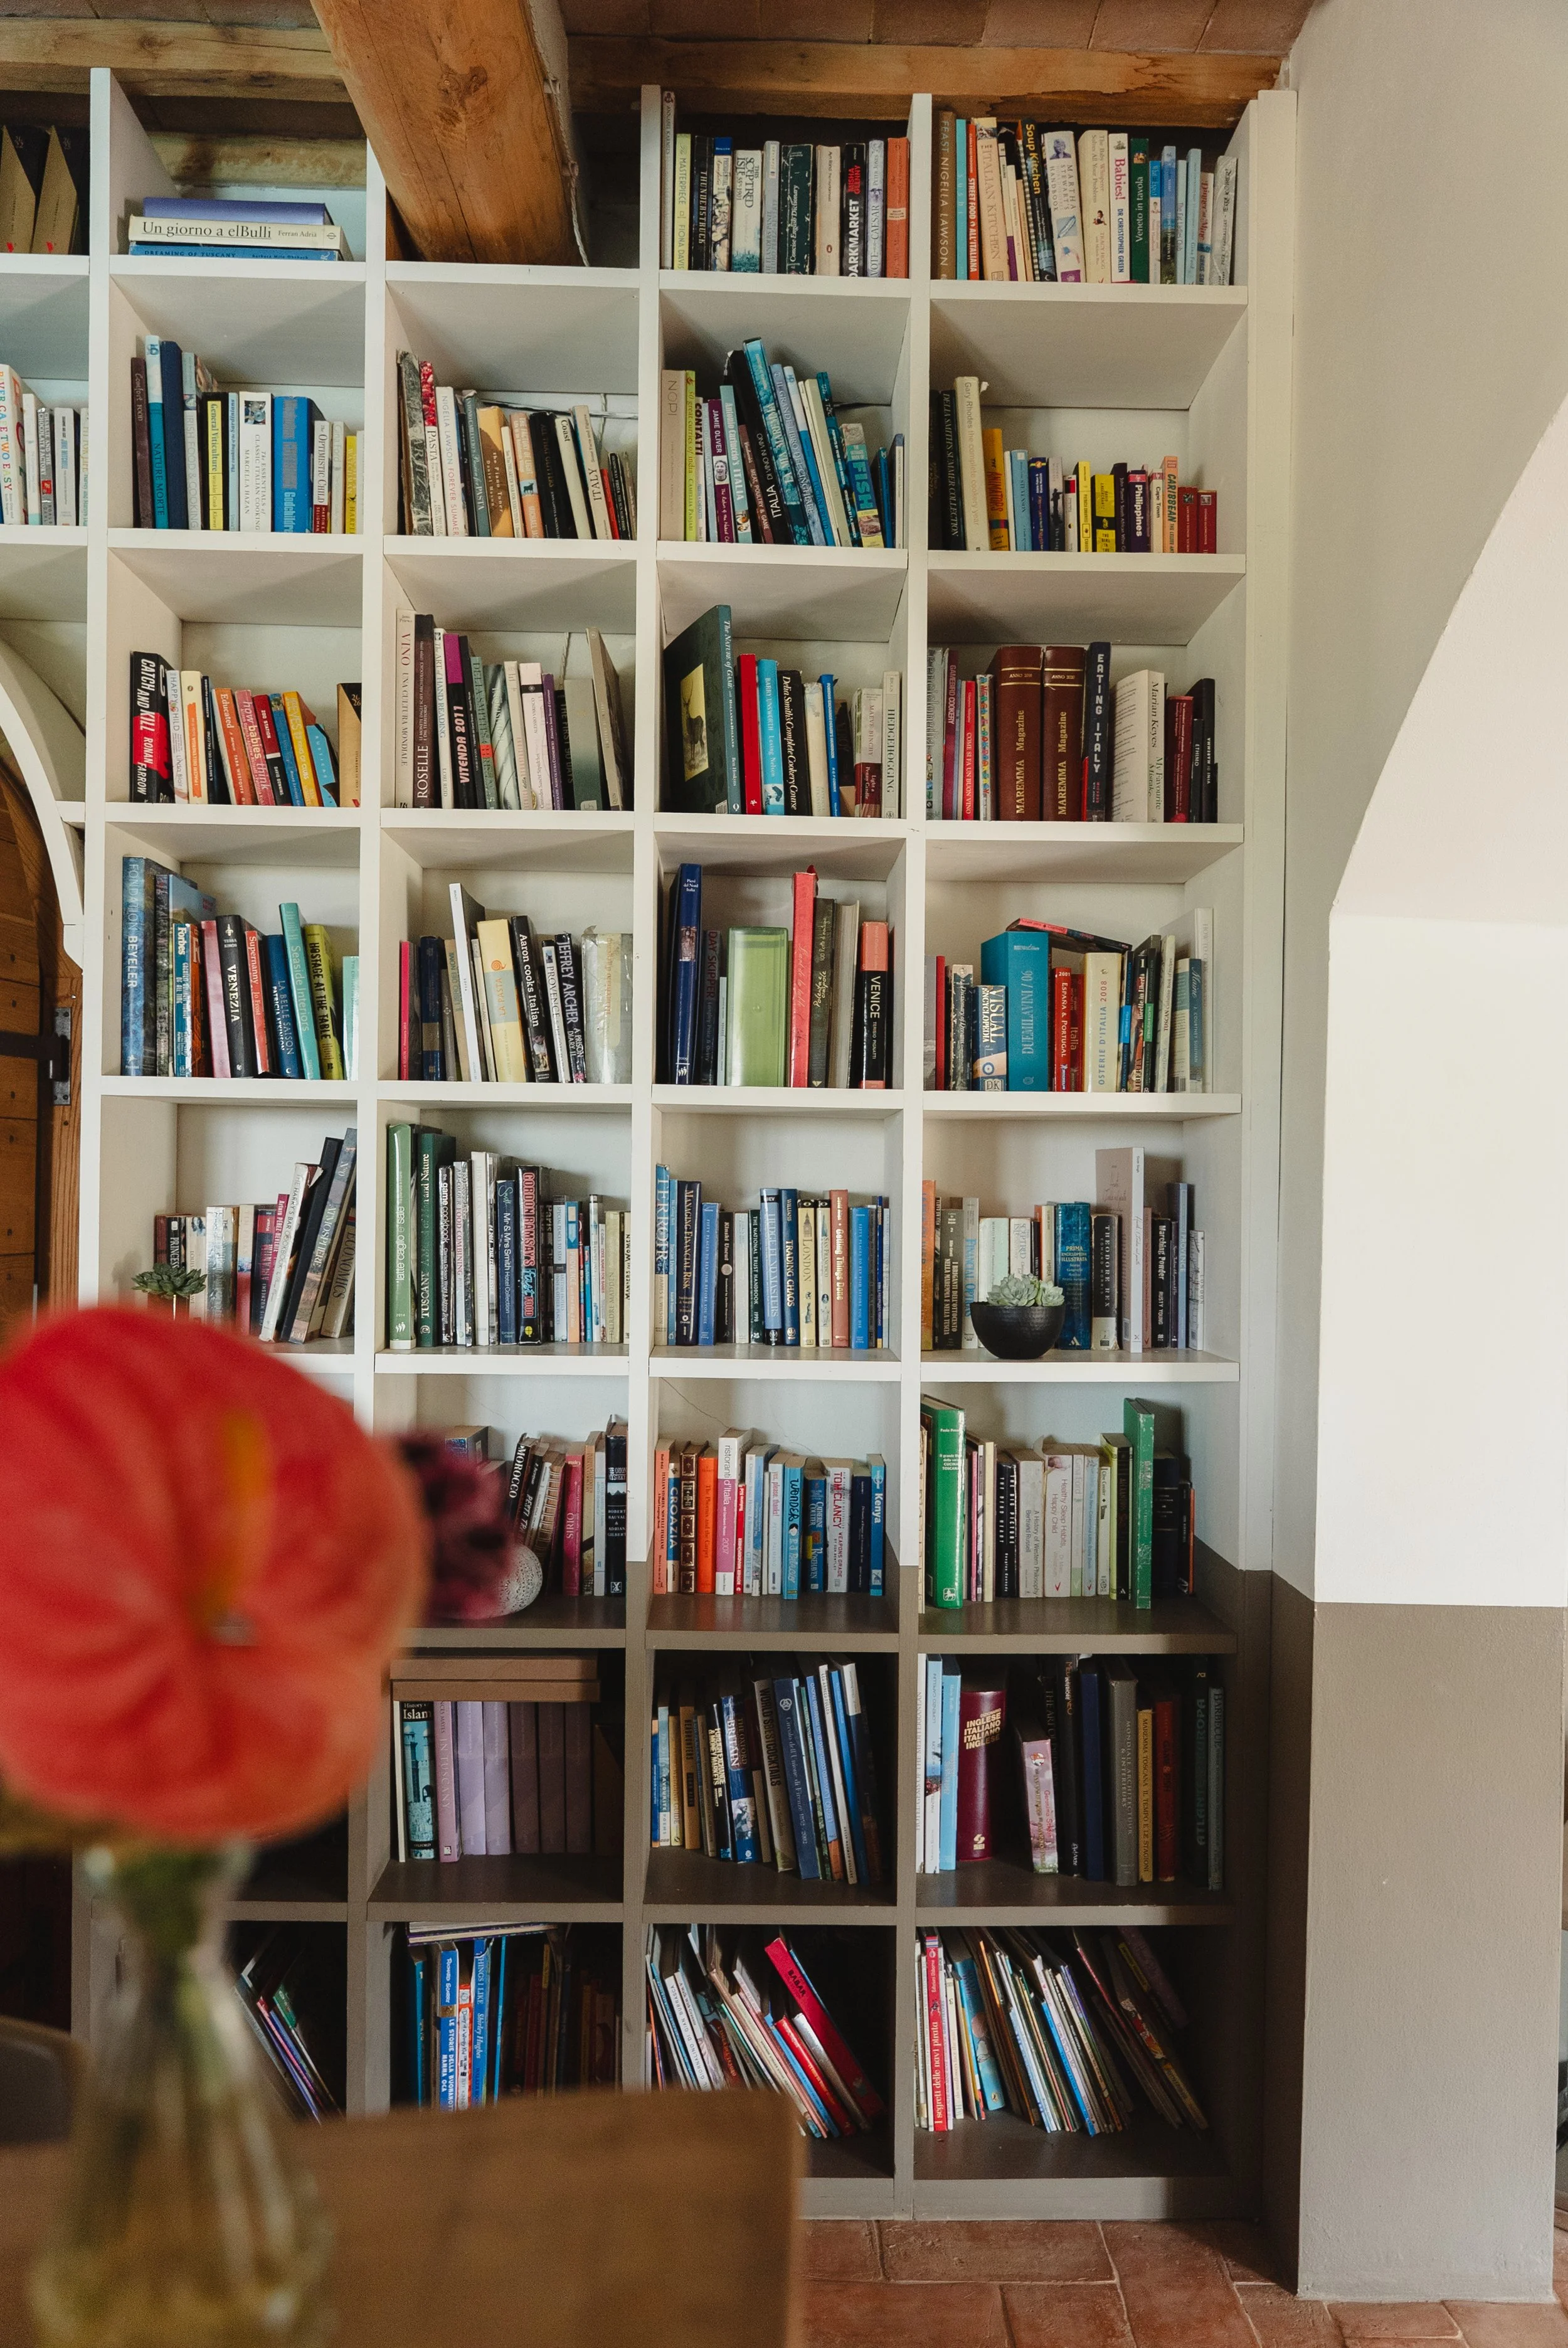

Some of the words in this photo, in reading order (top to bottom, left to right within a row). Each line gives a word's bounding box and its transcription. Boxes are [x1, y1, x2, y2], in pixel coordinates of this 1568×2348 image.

[1026, 124, 1035, 151] Soup
[679, 158, 687, 205] MASTERPIECE
[736, 157, 744, 176] ISLE
[1029, 153, 1041, 194] Kitchen
[1115, 158, 1126, 200] Babies!
[745, 157, 754, 208] SCEPTRED
[699, 171, 707, 244] THUNDERSTRUCK
[143, 222, 162, 234] Un
[167, 223, 212, 238] giorno
[228, 224, 271, 238] elBulli
[792, 218, 800, 238] English
[668, 381, 677, 416] NOPI
[943, 394, 951, 417] DELIA
[211, 403, 219, 431] General
[561, 420, 571, 442] Coast
[712, 410, 721, 428] JAMIE
[725, 403, 734, 428] Antonio
[427, 430, 437, 461] PASTA
[714, 430, 723, 452] OLIVER
[729, 430, 738, 466] Carluccio's
[945, 418, 953, 449] SMITH'S
[153, 443, 162, 486] NATURE
[211, 433, 220, 471] Viticulture
[946, 451, 955, 486] SUMMER
[587, 468, 602, 501] ITALY
[734, 469, 743, 500] ITALIA
[852, 461, 873, 509] FISH
[1167, 474, 1176, 522] CARIBBEAN
[156, 488, 164, 515] MORTE
[948, 488, 958, 536] COLLECTION
[1135, 484, 1143, 536] Philippines
[401, 633, 410, 666] VINO
[141, 659, 156, 690] CATCH
[781, 676, 791, 696] Delia
[137, 689, 150, 708] AND
[220, 694, 234, 728] Educated
[783, 696, 792, 721] Smith's
[139, 709, 155, 731] KILL
[453, 706, 464, 732] 2011
[1058, 712, 1066, 752] Magazine
[1150, 720, 1158, 747] Keyes
[143, 737, 153, 763] RONAN
[783, 721, 795, 755] Complete
[887, 709, 896, 793] HEDGEHOGGING
[417, 746, 428, 798] ROSELLE
[456, 736, 469, 783] VITENDA
[787, 755, 795, 785] Cookery
[137, 762, 147, 795] FARROW
[1057, 762, 1067, 814] MAREMMA
[790, 785, 798, 810] Course
[128, 864, 137, 930] FONDATION
[177, 927, 187, 955] Forbes
[519, 935, 531, 962] Aaron
[127, 936, 137, 987] BEYELER
[310, 943, 324, 979] HOSTAGE
[557, 941, 574, 979] JEFFREY
[227, 965, 240, 1022] VENEZIA
[315, 982, 325, 992] AT
[524, 965, 534, 992] cooks
[316, 996, 327, 1011] THE
[528, 995, 540, 1027] Italian
[563, 983, 578, 1024] ARCHER
[870, 976, 881, 1019] VENICE
[319, 1014, 332, 1039] TABLE
[982, 987, 992, 1043] ENCYCLOPEDIA
[990, 989, 1004, 1043] VISUAL
[1098, 1007, 1106, 1046] D'ITALIA
[440, 1182, 450, 1205] game
[524, 1172, 536, 1214] GORDON
[442, 1206, 450, 1243] cookbook
[657, 1176, 669, 1262] TERROIR
[524, 1216, 536, 1266] RAMSAY'S
[835, 1229, 844, 1255] Getting
[1157, 1225, 1167, 1256] Marching
[786, 1240, 794, 1277] TRADING
[802, 1238, 813, 1282] LONDON
[836, 1257, 844, 1280] Things
[1158, 1258, 1166, 1280] Powder
[522, 1270, 536, 1295] fast
[524, 1297, 533, 1316] FOOD
[509, 1448, 526, 1498] MOROCCO
[723, 1445, 733, 1479] ristoranti
[723, 1480, 733, 1504] d'Italia
[833, 1472, 842, 1490] TOM
[789, 1479, 800, 1522] WONDER
[833, 1492, 842, 1529] CLANCY
[874, 1493, 883, 1523] Kenya
[964, 1720, 1001, 1735] ITALIANO
[964, 1727, 1000, 1743] ITALIANO
[967, 1713, 1001, 1728] INGLESE
[727, 1719, 739, 1766] BRITAIN
[966, 1733, 1000, 1750] INGLESE
[788, 1970, 805, 1996] BABAR
[475, 2013, 484, 2034] Shirley
[475, 2036, 483, 2058] Hughes
[934, 2073, 943, 2091] delle
[934, 2093, 942, 2115] segreti
